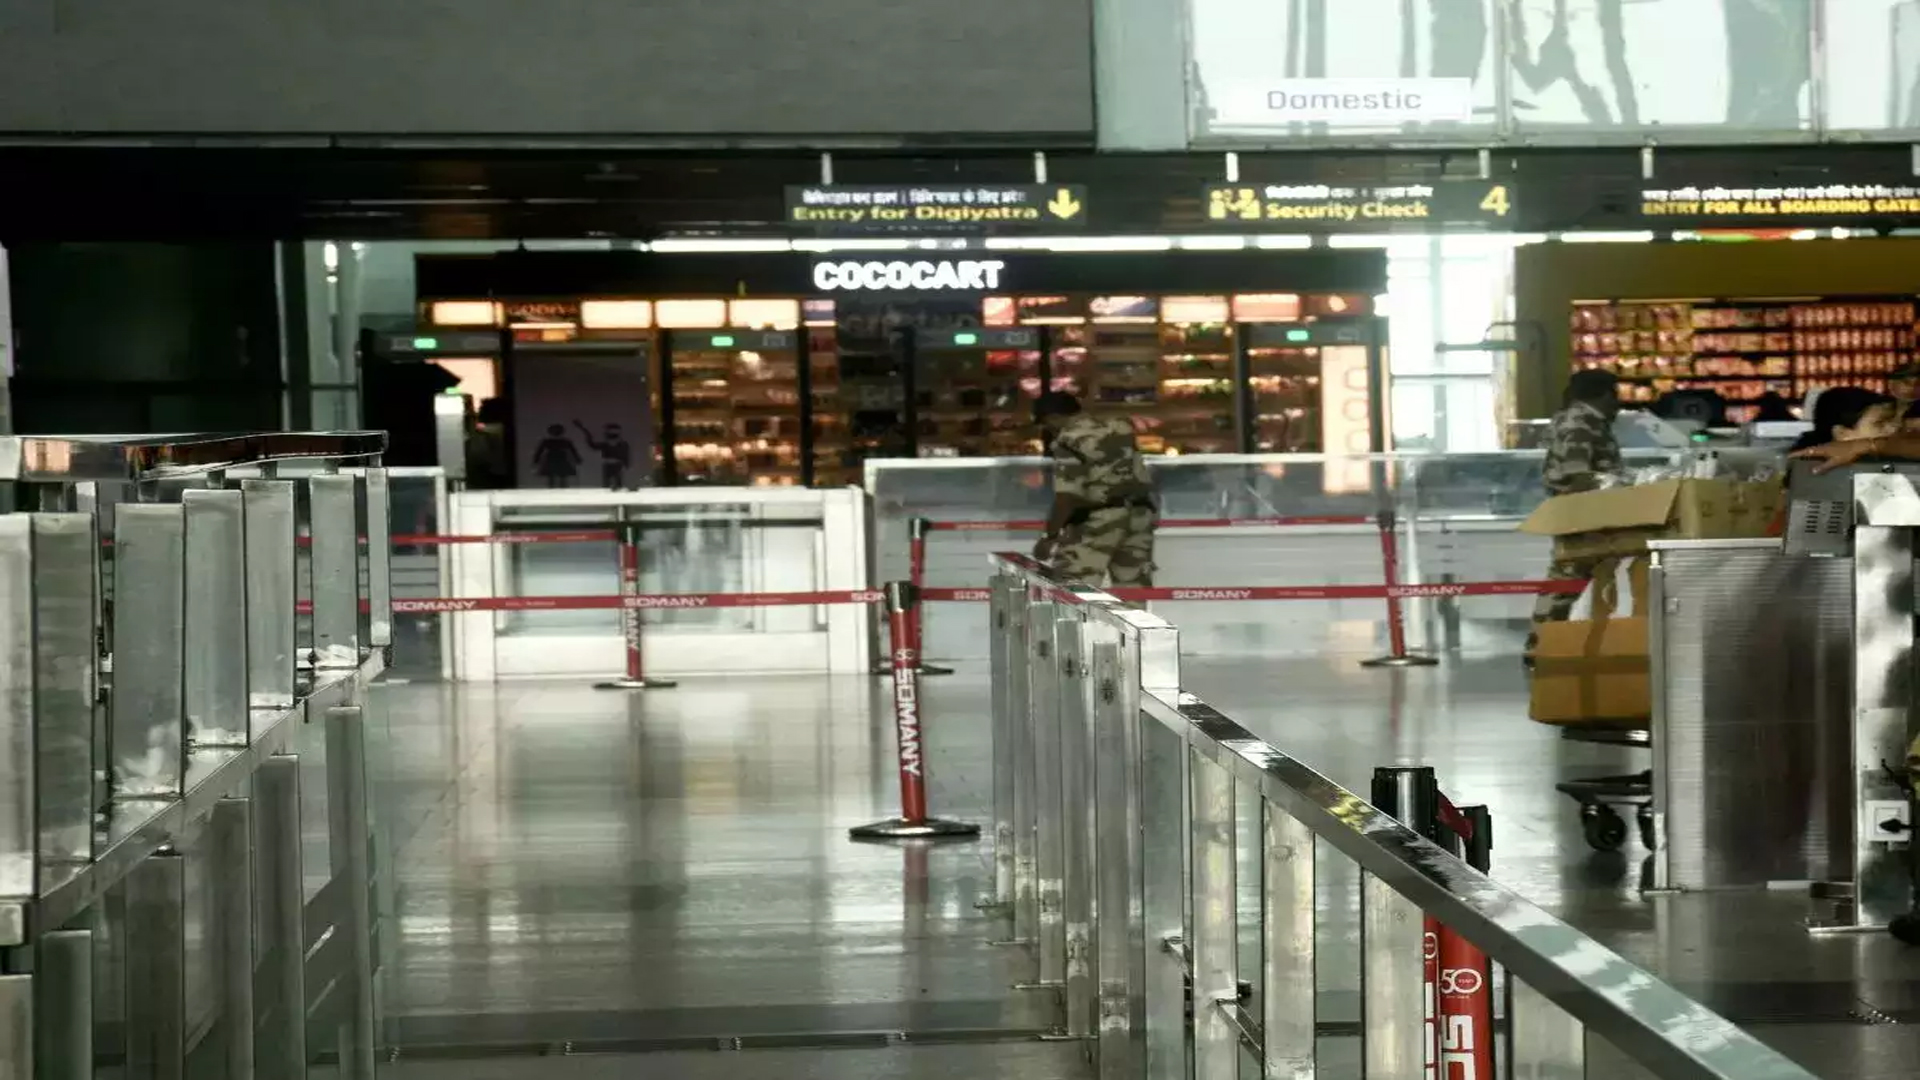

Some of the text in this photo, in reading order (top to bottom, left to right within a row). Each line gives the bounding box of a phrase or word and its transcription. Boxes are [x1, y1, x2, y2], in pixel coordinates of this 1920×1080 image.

[1267, 89, 1422, 111] Domestic
[1479, 186, 1510, 216] 4
[1642, 201, 1699, 215] ENTRY
[1703, 200, 1739, 214] FOR
[1742, 200, 1777, 214] ALL
[1780, 199, 1871, 214] BOARDING
[793, 205, 1039, 222] Entry for Digiyatra
[1267, 201, 1429, 221] Security Check
[814, 259, 1004, 290] COCOCART
[1171, 589, 1251, 600] SOMANY
[1387, 585, 1465, 597] SOMANY
[392, 600, 477, 612] SOMANY
[624, 596, 708, 608] SOMANY
[896, 667, 921, 777] SOMANY
[1441, 968, 1482, 994] 50
